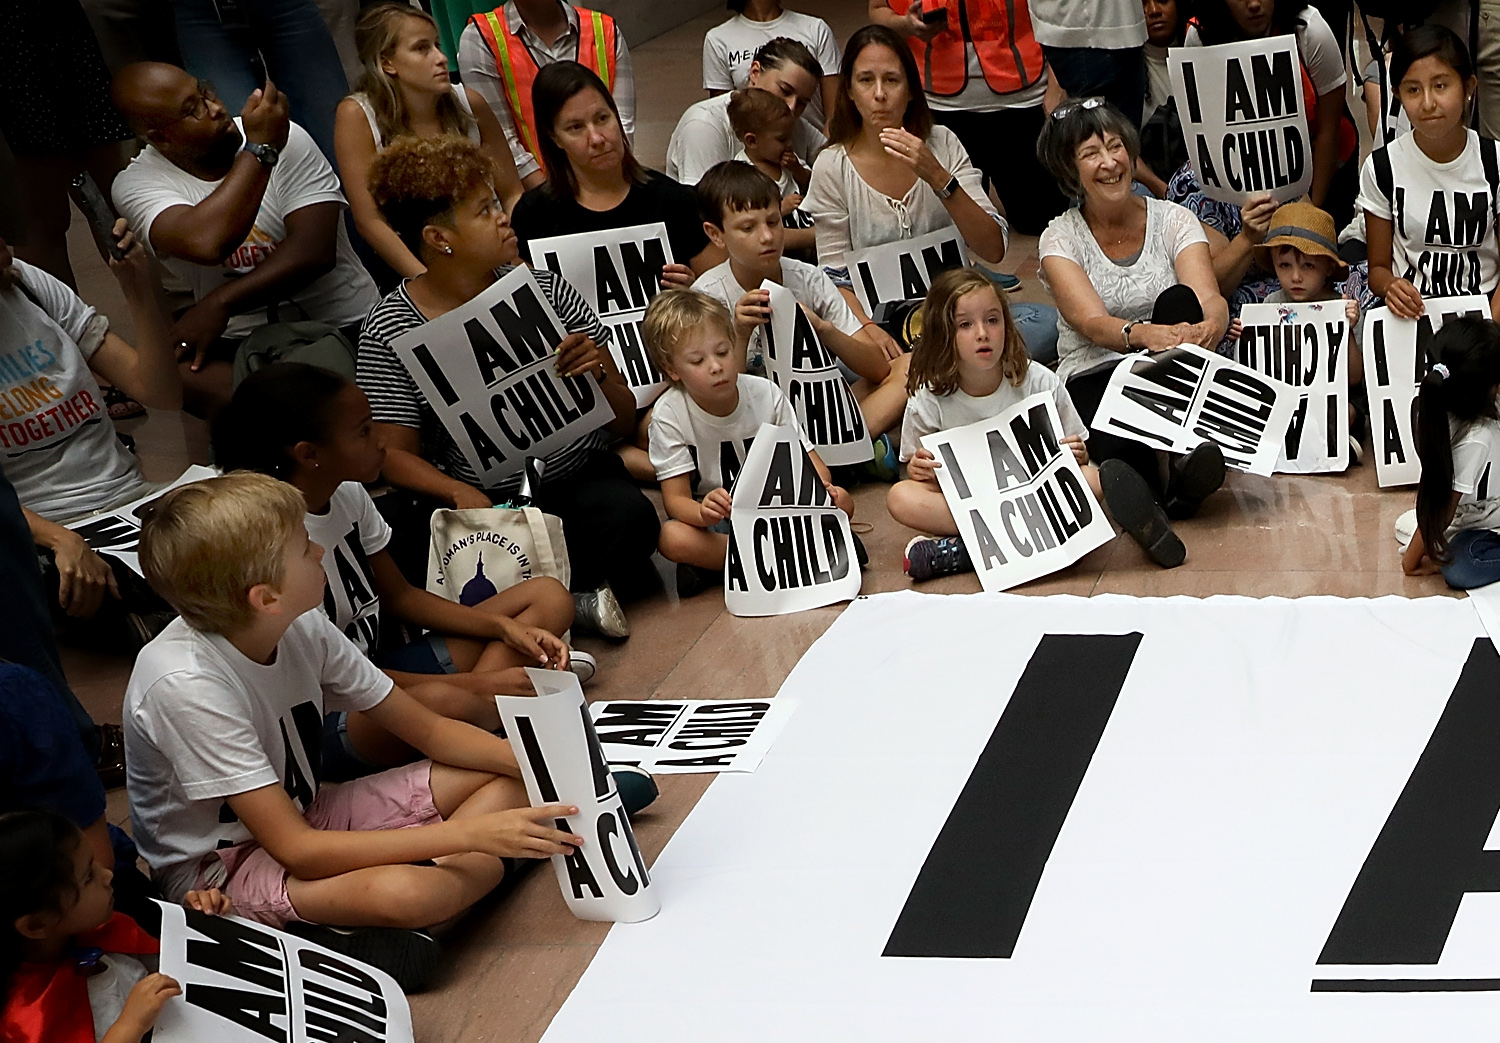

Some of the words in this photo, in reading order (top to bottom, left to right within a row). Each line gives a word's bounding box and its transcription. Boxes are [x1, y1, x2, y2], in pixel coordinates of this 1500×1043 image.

[1182, 62, 1202, 123] I
[1226, 51, 1297, 122] AM
[1196, 134, 1221, 188] A
[1222, 126, 1304, 192] CHILD
[1424, 190, 1488, 246] AM
[857, 262, 879, 317] I
[1418, 251, 1482, 295] CHILD
[412, 344, 460, 406] I
[464, 282, 564, 386] AM
[1325, 321, 1345, 383] A
[1373, 319, 1389, 386] I
[0, 390, 100, 449] TOGETHER
[459, 412, 507, 471] A
[490, 369, 596, 450] CHILD
[1121, 349, 1207, 426] AM
[1192, 368, 1277, 455] CHILD
[937, 443, 972, 499] I
[986, 403, 1061, 490] AM
[1109, 417, 1174, 447] I
[1327, 395, 1338, 457] I
[1383, 398, 1406, 465] A
[969, 509, 1008, 571] A
[1000, 466, 1092, 557] CHILD
[438, 534, 474, 575] OMAN'S
[476, 531, 508, 548] PLACE
[506, 542, 521, 555] IS
[517, 554, 530, 567] IN
[753, 513, 849, 592] CHILD
[593, 703, 684, 747] AM
[668, 702, 771, 750] CHILD
[515, 716, 560, 803] I
[654, 754, 738, 766] A
[881, 632, 1141, 957] I
